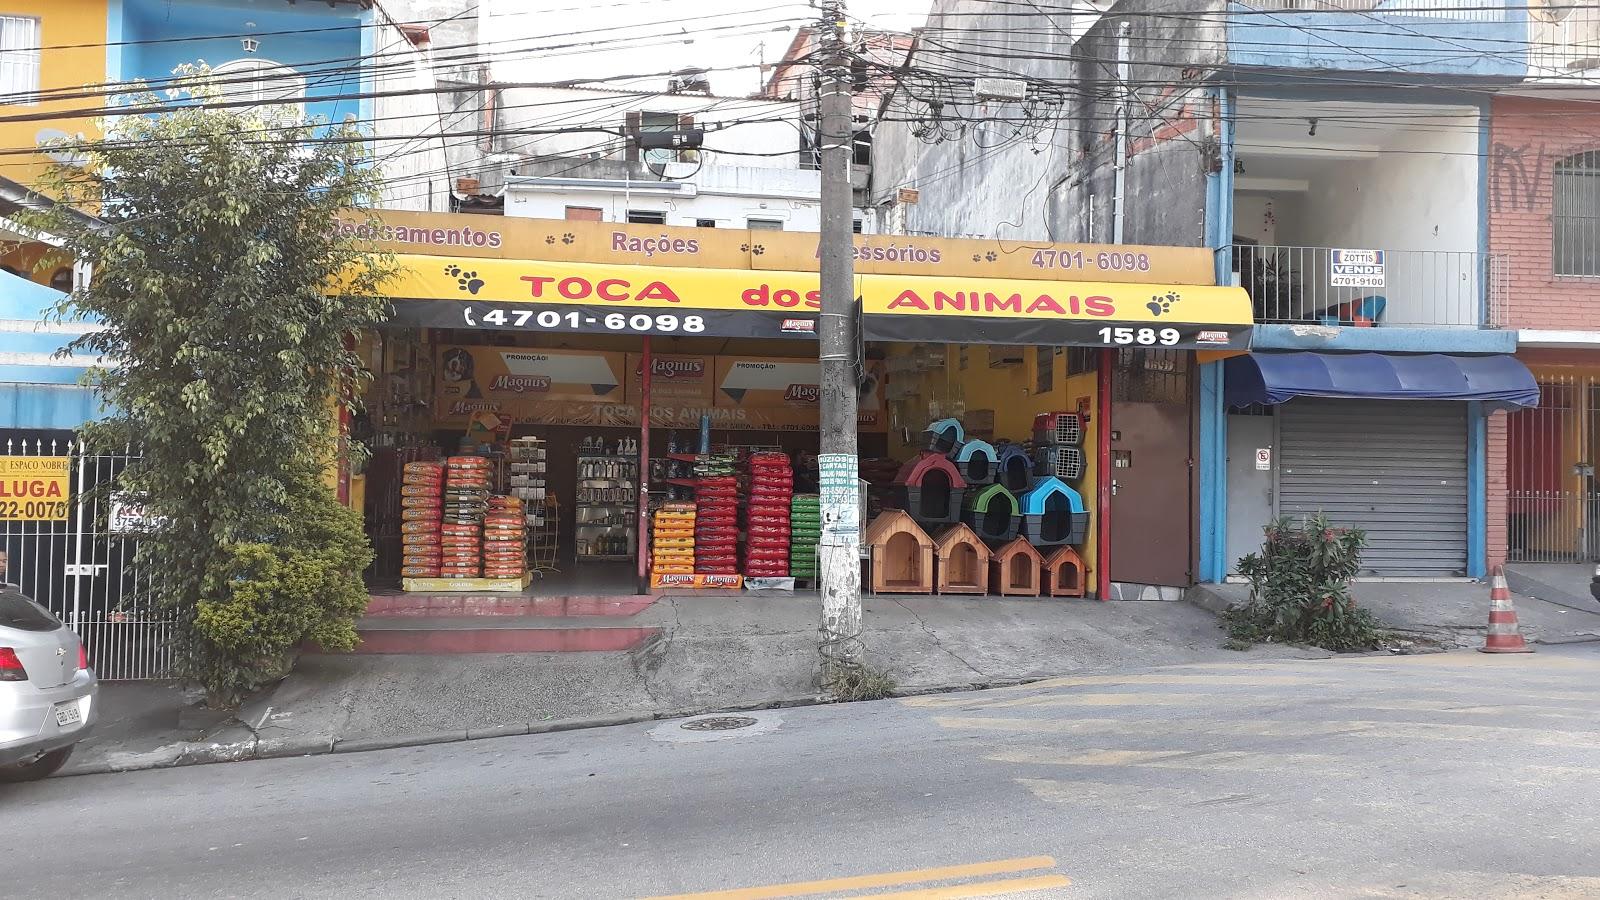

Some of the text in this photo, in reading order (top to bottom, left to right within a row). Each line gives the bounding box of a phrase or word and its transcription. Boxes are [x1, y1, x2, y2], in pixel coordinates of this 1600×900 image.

[611, 231, 699, 257] Rações
[814, 242, 941, 263] essórios
[1344, 254, 1374, 262] ZOTTIS
[1334, 265, 1383, 274] VENDE
[1333, 277, 1383, 286] 4701-9100
[520, 276, 680, 303] TOCA
[887, 289, 1115, 317] ANIMAIS
[483, 309, 705, 333] 4701-6098
[1098, 327, 1181, 346] 1589
[1197, 331, 1228, 341] Magnus
[637, 358, 702, 378] Magnus
[736, 362, 776, 370] PROMOÇÃO!
[489, 375, 548, 392] Magnus
[783, 383, 820, 399] Magn
[679, 407, 746, 420] ANIMAIS
[658, 574, 737, 586] Magnus Magnus
